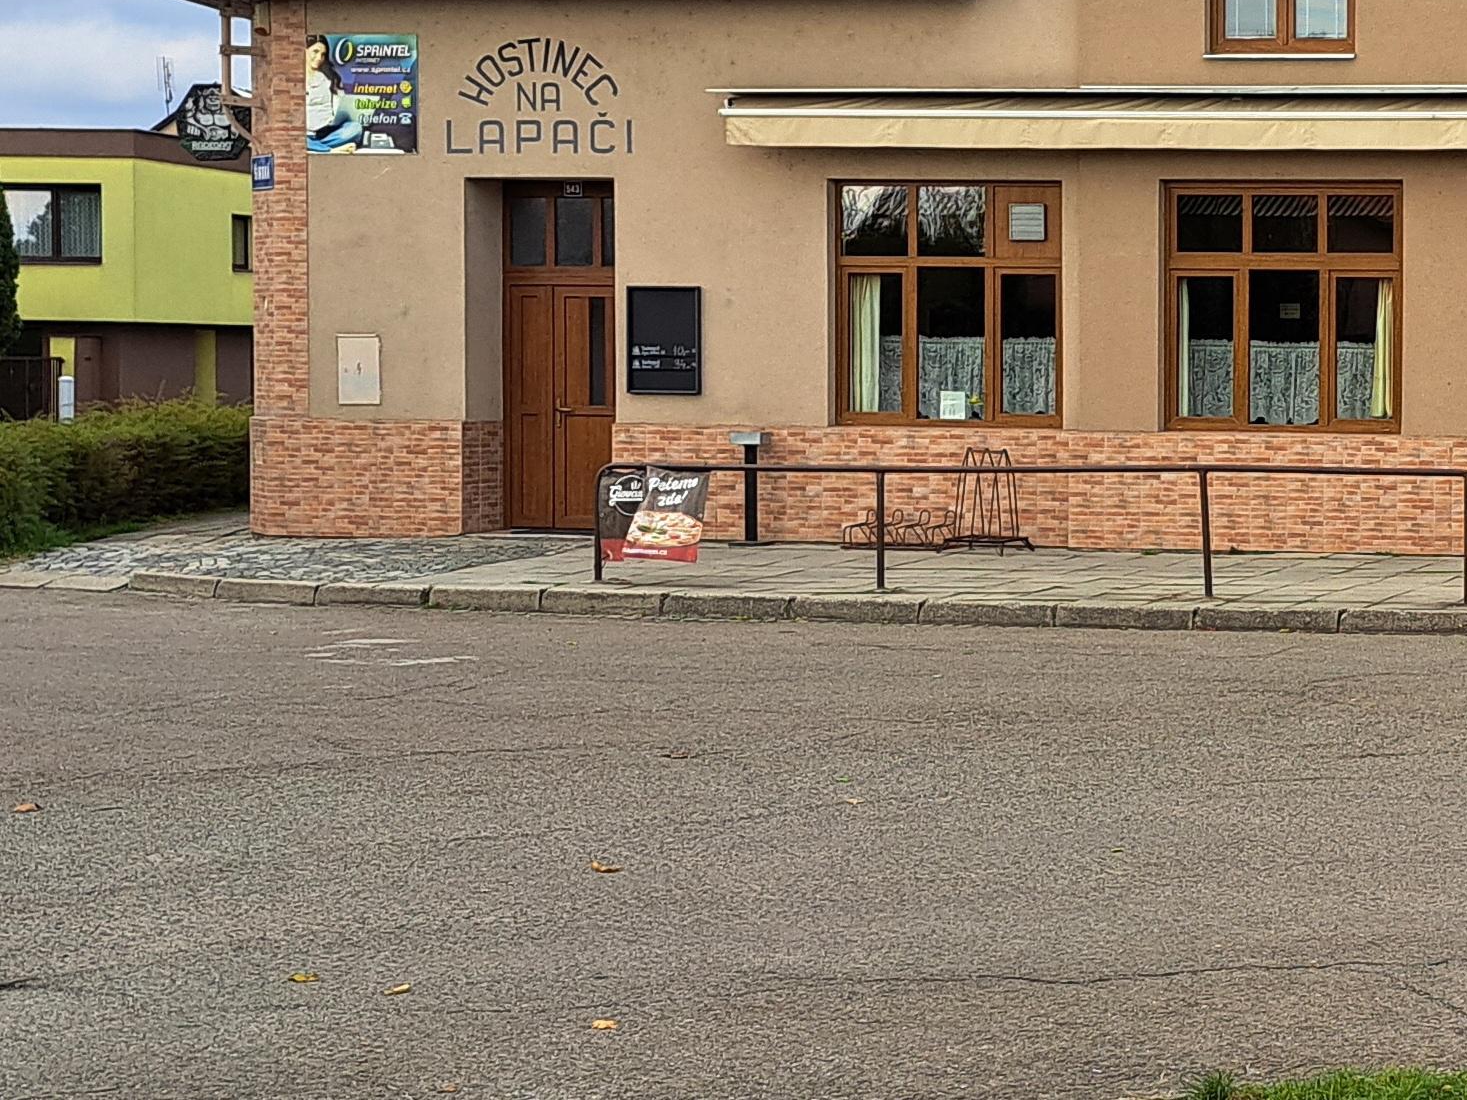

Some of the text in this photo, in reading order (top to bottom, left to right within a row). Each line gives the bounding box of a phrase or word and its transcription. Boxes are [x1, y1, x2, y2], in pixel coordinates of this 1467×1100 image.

[458, 38, 618, 106] HOSTINEC
[353, 83, 398, 94] internet
[517, 82, 560, 112] NA
[354, 98, 398, 110] televize
[359, 112, 398, 126] telefon
[446, 112, 633, 154] LAPAČI
